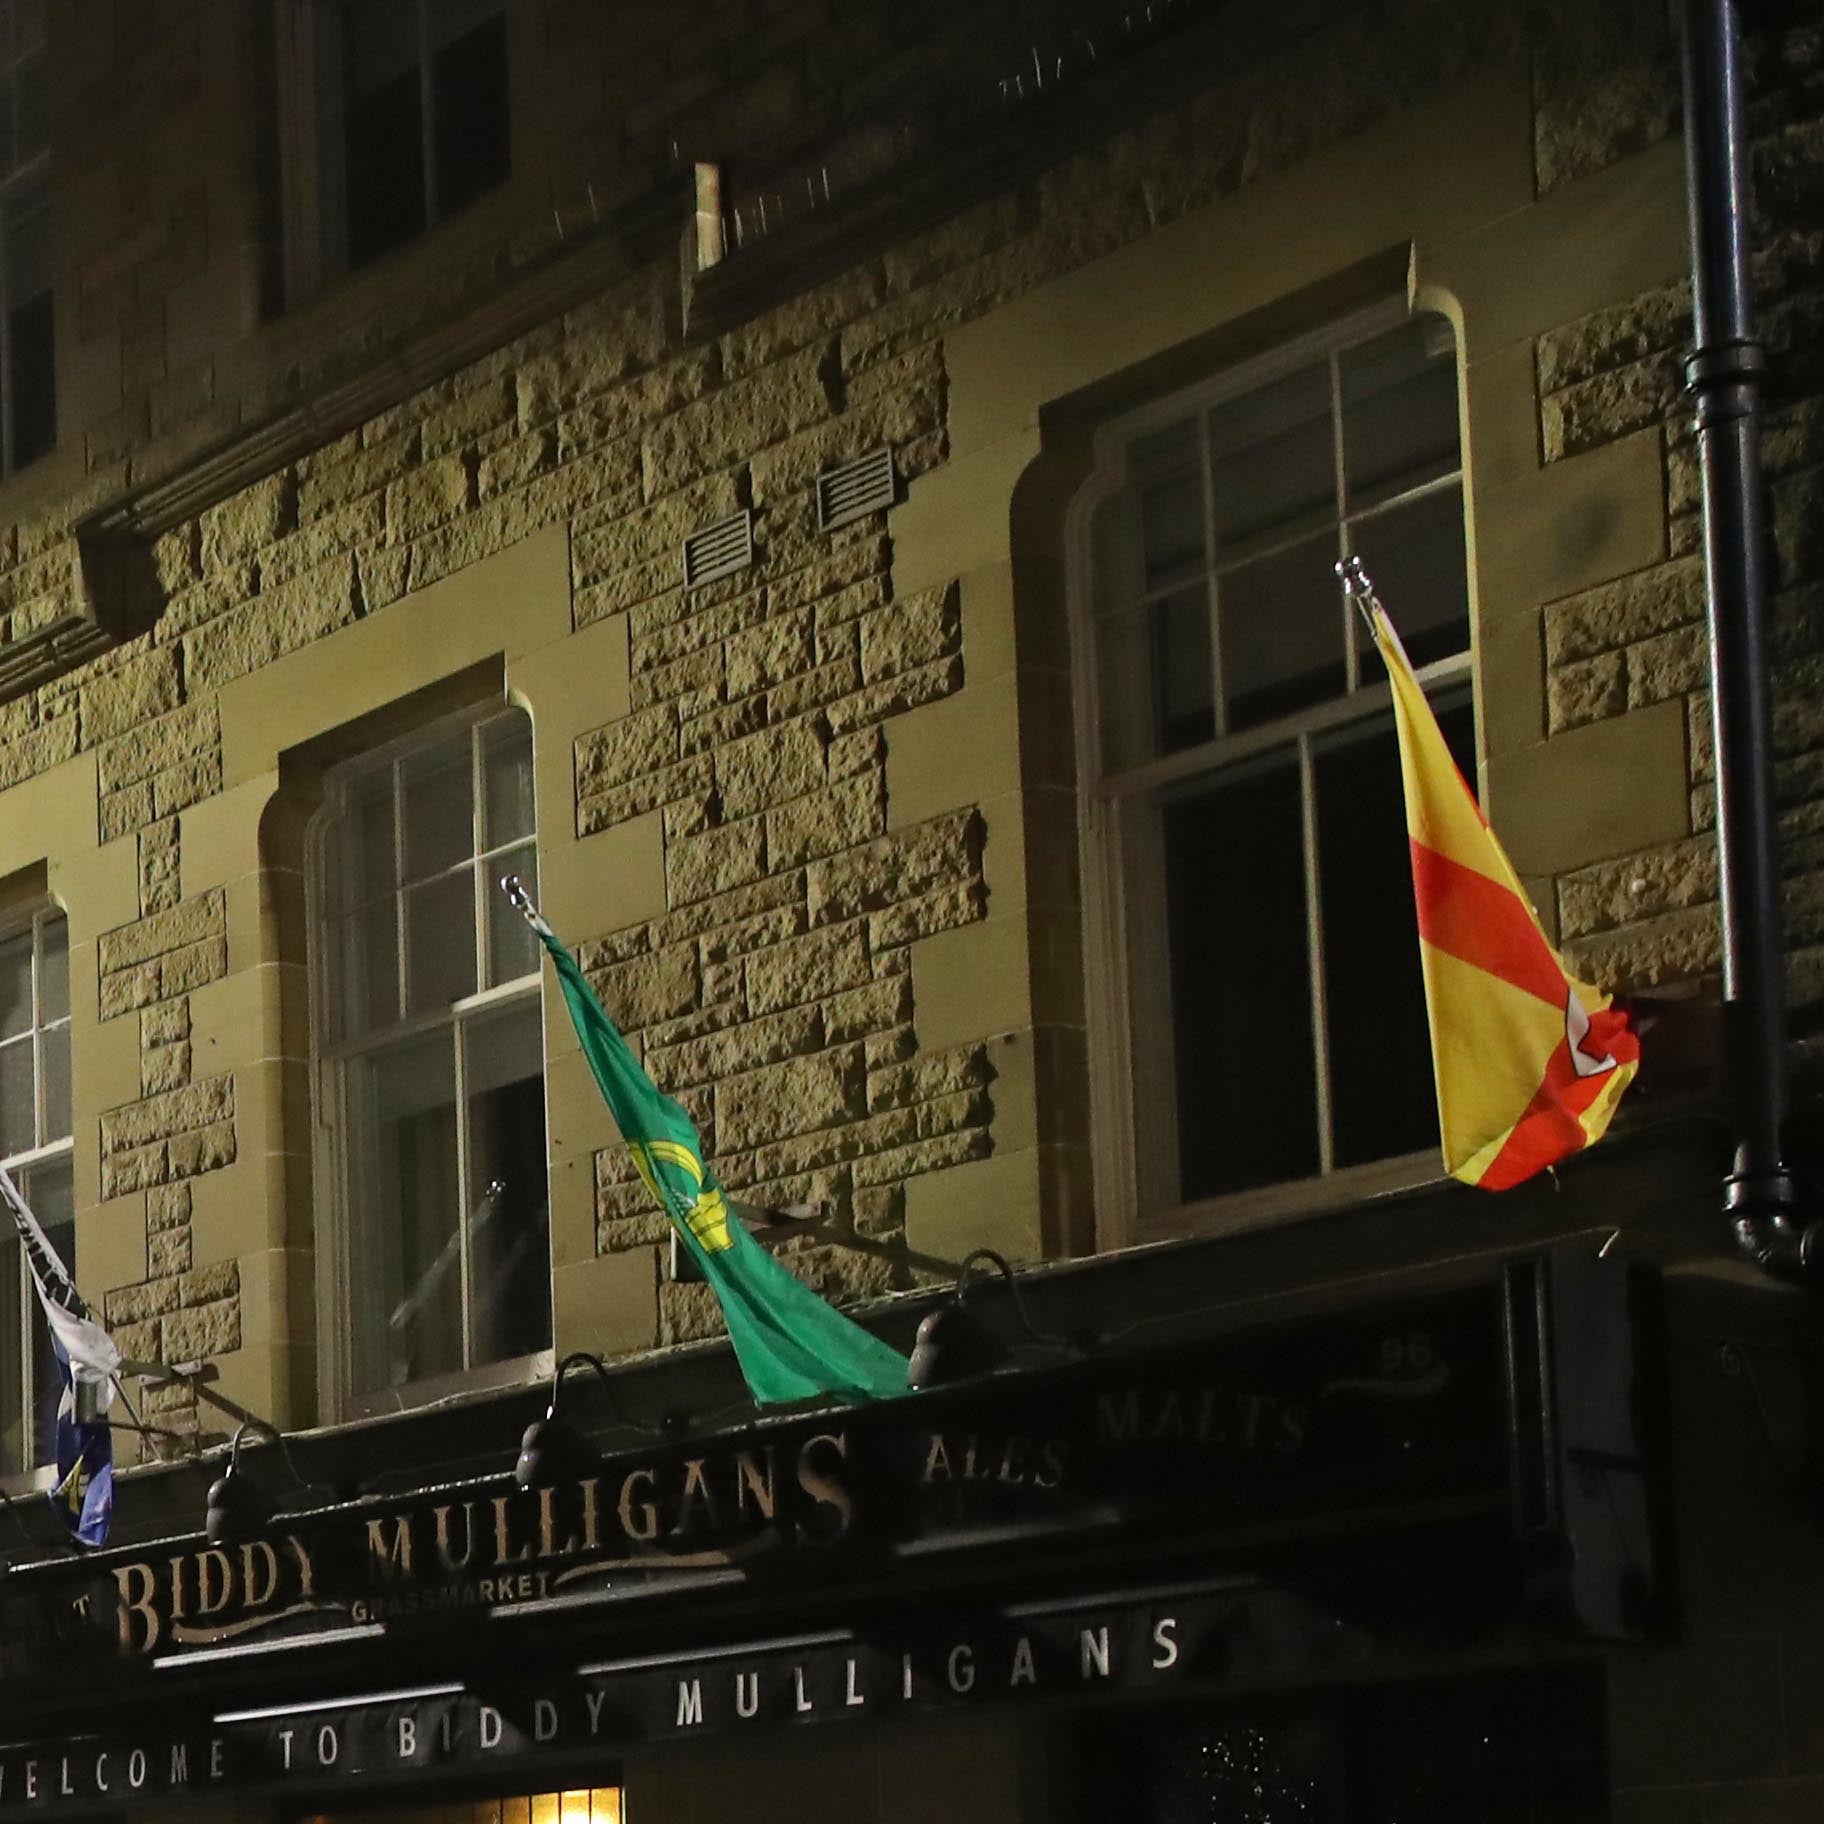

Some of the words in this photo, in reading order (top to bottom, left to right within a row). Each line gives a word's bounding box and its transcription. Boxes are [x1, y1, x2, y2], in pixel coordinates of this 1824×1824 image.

[921, 1433, 1070, 1489] ALES
[1096, 1390, 1311, 1452] MALTS
[111, 1535, 315, 1656] BIDDY
[366, 1433, 854, 1578] MULLIGANS
[278, 1724, 339, 1770] TO
[398, 1690, 608, 1759] BIDDY
[675, 1616, 1182, 1727] MULLIGANS
